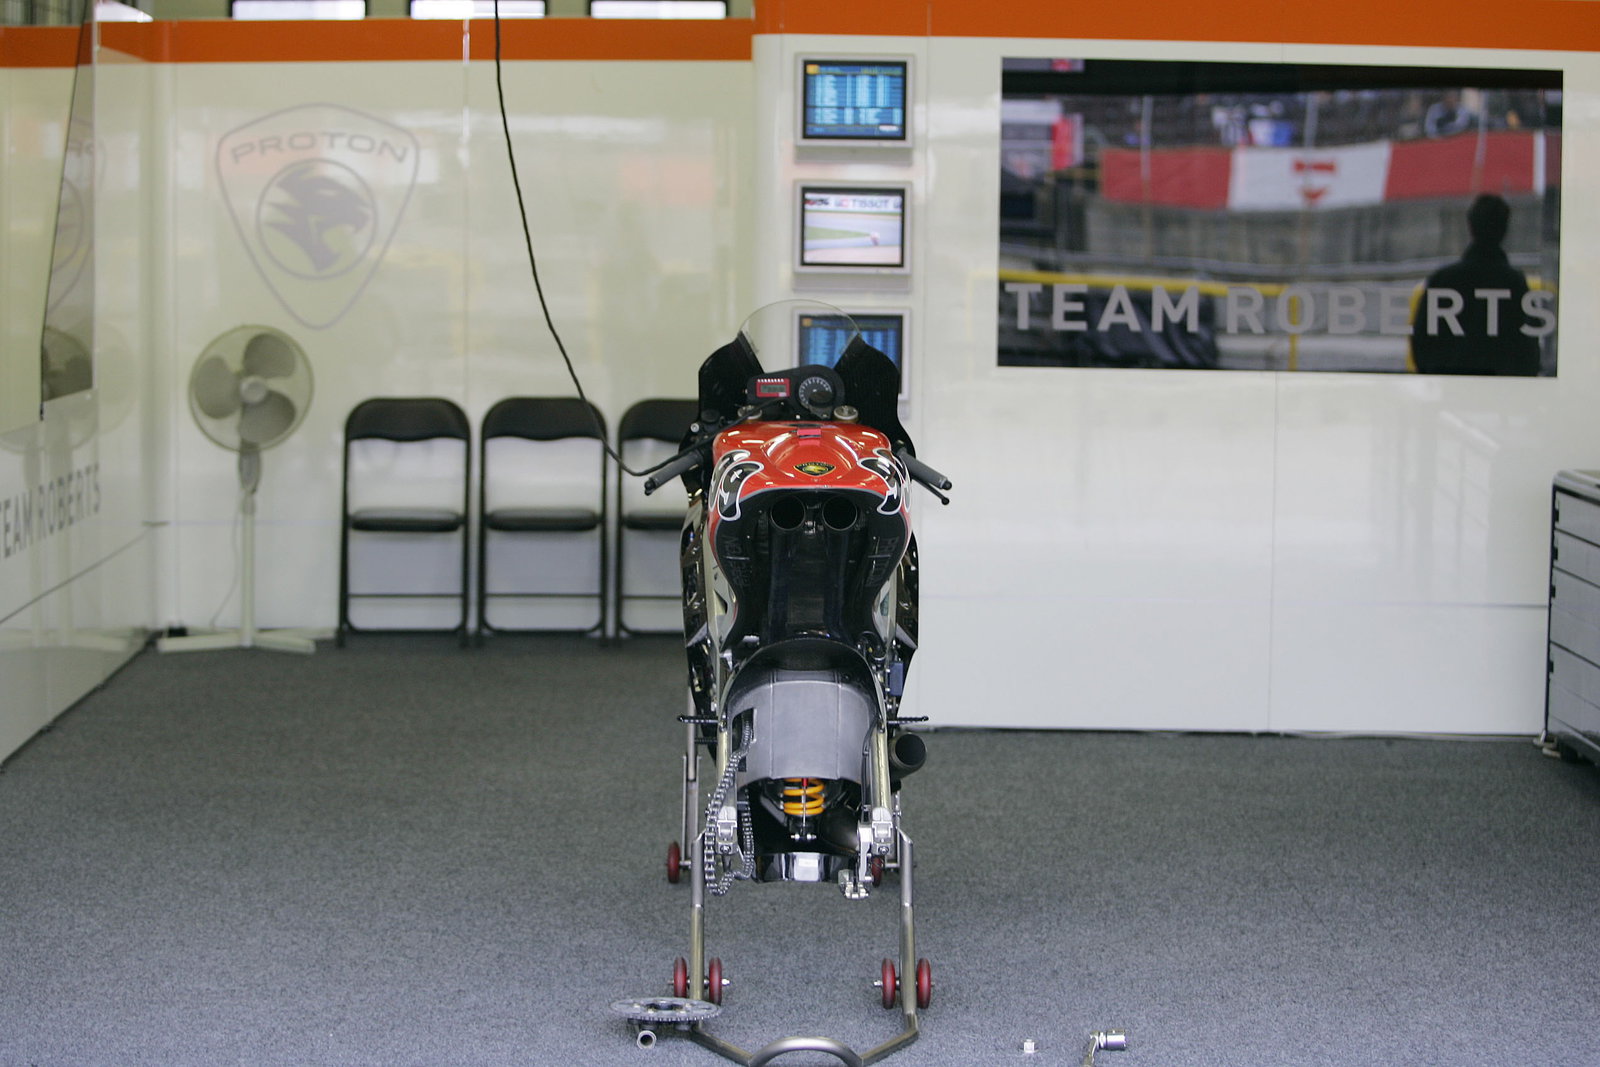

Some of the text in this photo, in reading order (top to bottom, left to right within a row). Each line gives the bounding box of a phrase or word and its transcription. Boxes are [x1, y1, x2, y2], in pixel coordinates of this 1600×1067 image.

[230, 131, 407, 164] PROTON
[1004, 282, 1556, 337] TEAM ROBERTS
[0, 462, 100, 560] EAM ROBERTS
